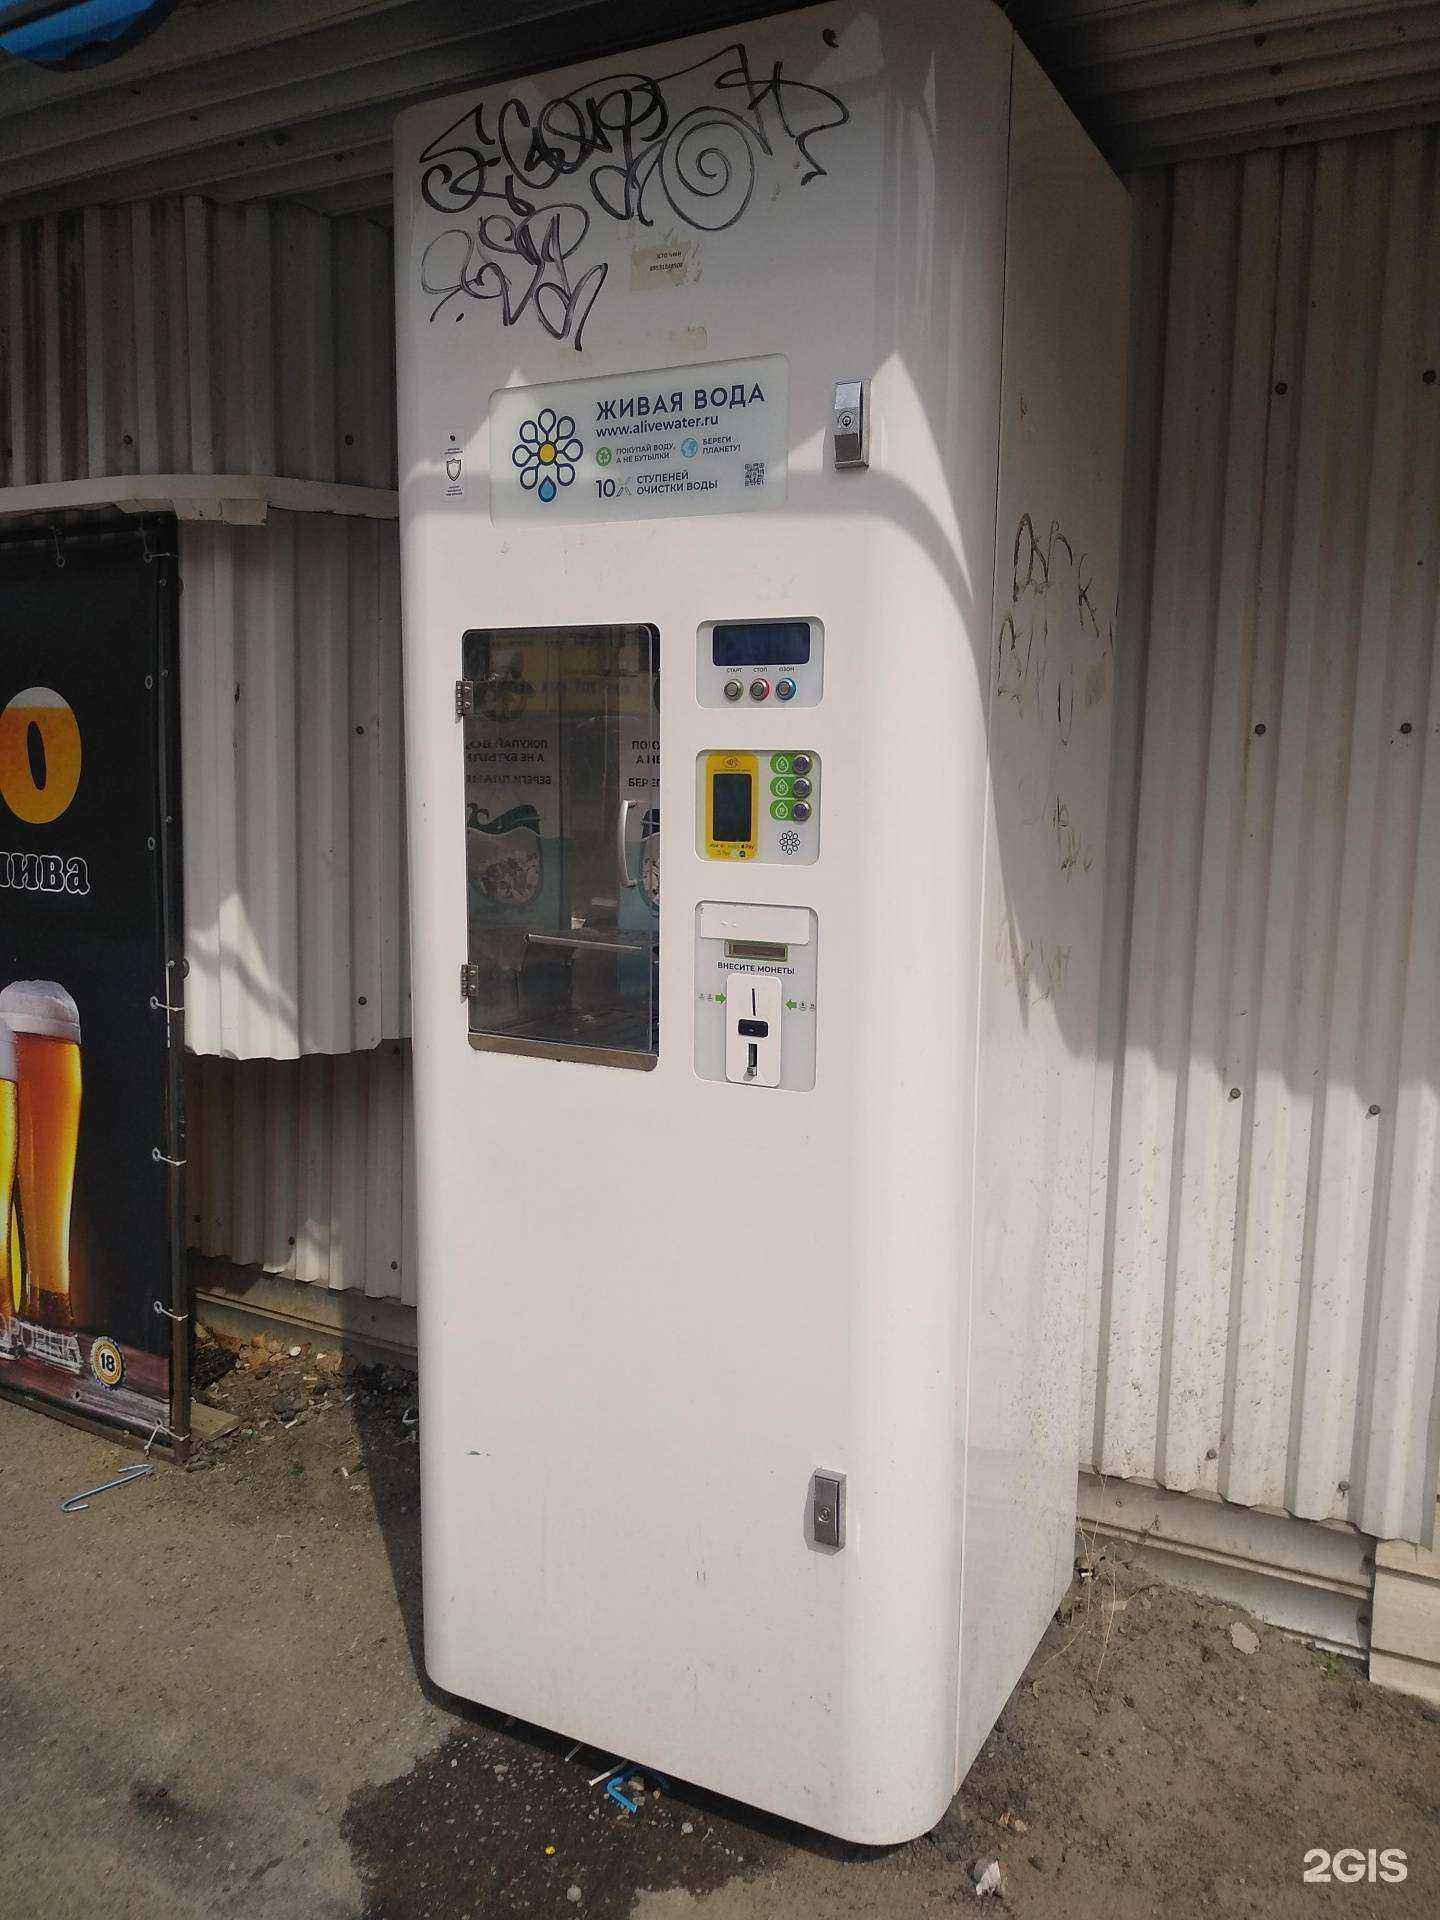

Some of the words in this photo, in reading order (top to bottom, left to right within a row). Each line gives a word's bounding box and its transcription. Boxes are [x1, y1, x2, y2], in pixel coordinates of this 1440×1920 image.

[596, 391, 683, 421] ЖИВАЯ
[694, 382, 766, 410] ВОДА
[595, 415, 719, 438] www.alivewater.ru
[702, 436, 732, 446] БЕРЕГИ
[615, 444, 652, 455] ПОКУПАЙ
[702, 444, 741, 454] ПЛАНЕТУ!
[634, 453, 670, 463] БУТЫЛКИ
[636, 469, 689, 484] СТУПЕНЕЙ
[636, 483, 684, 495] ОЧИСТКИ
[686, 479, 718, 491] ВОДЫ
[717, 961, 755, 973] ВНЕСИТЕ
[757, 965, 795, 975] МОНЕТЫ
[100, 1352, 116, 1372] 18
